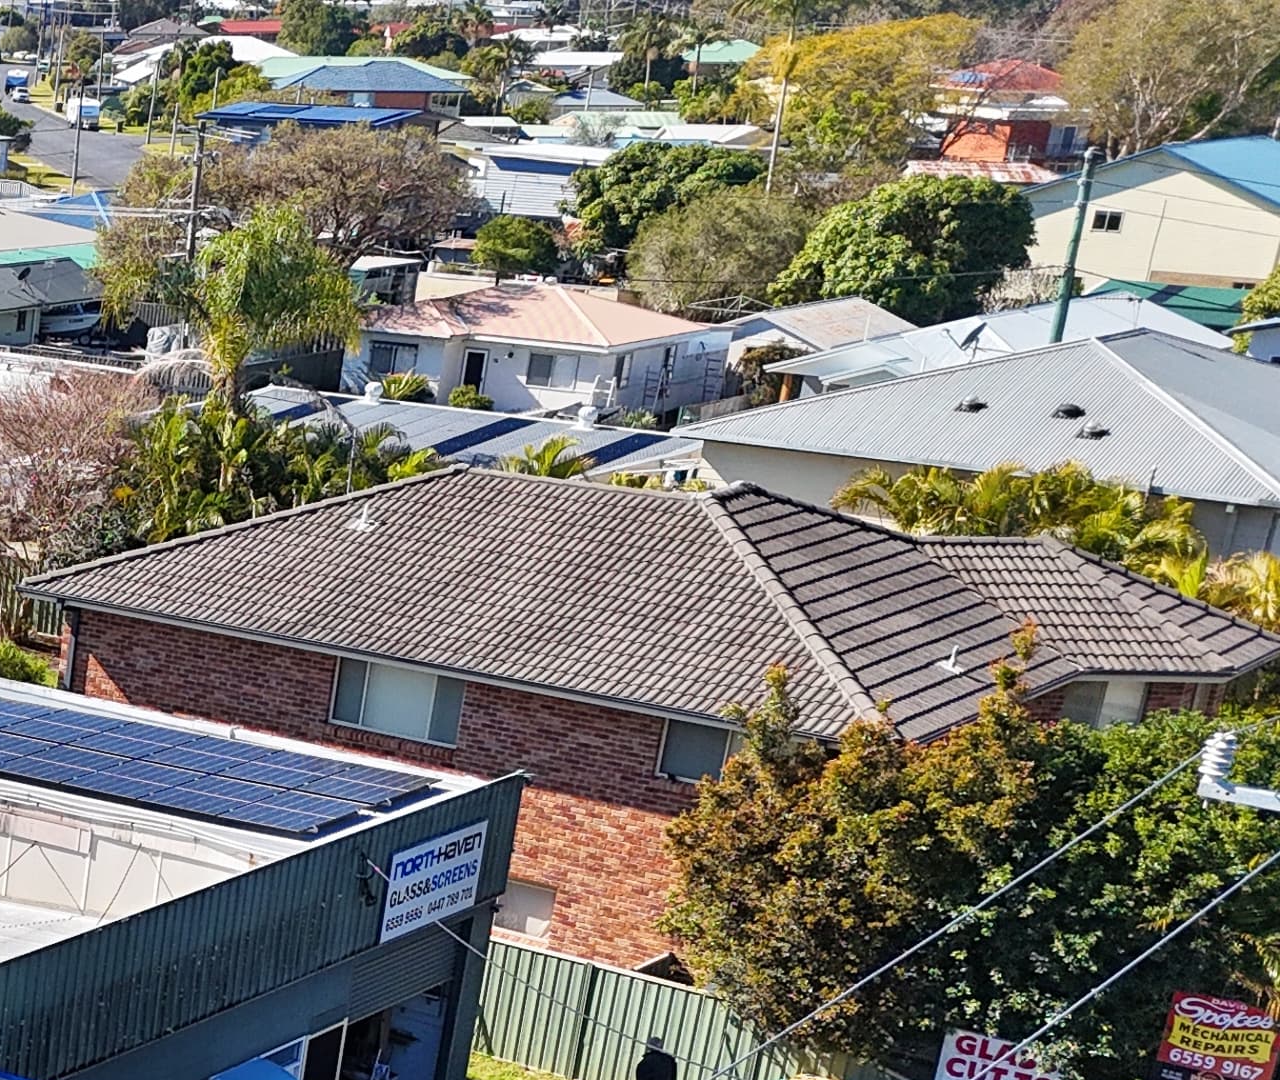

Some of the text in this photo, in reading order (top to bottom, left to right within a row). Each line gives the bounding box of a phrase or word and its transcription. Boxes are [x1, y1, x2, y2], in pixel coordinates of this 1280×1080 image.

[1174, 997, 1274, 1030] Spokes
[1179, 1022, 1271, 1044] MECHANICAL
[1180, 1035, 1260, 1055] REPAIRS
[955, 1035, 1057, 1073] GLAS
[1169, 1048, 1264, 1080] 6559 9167
